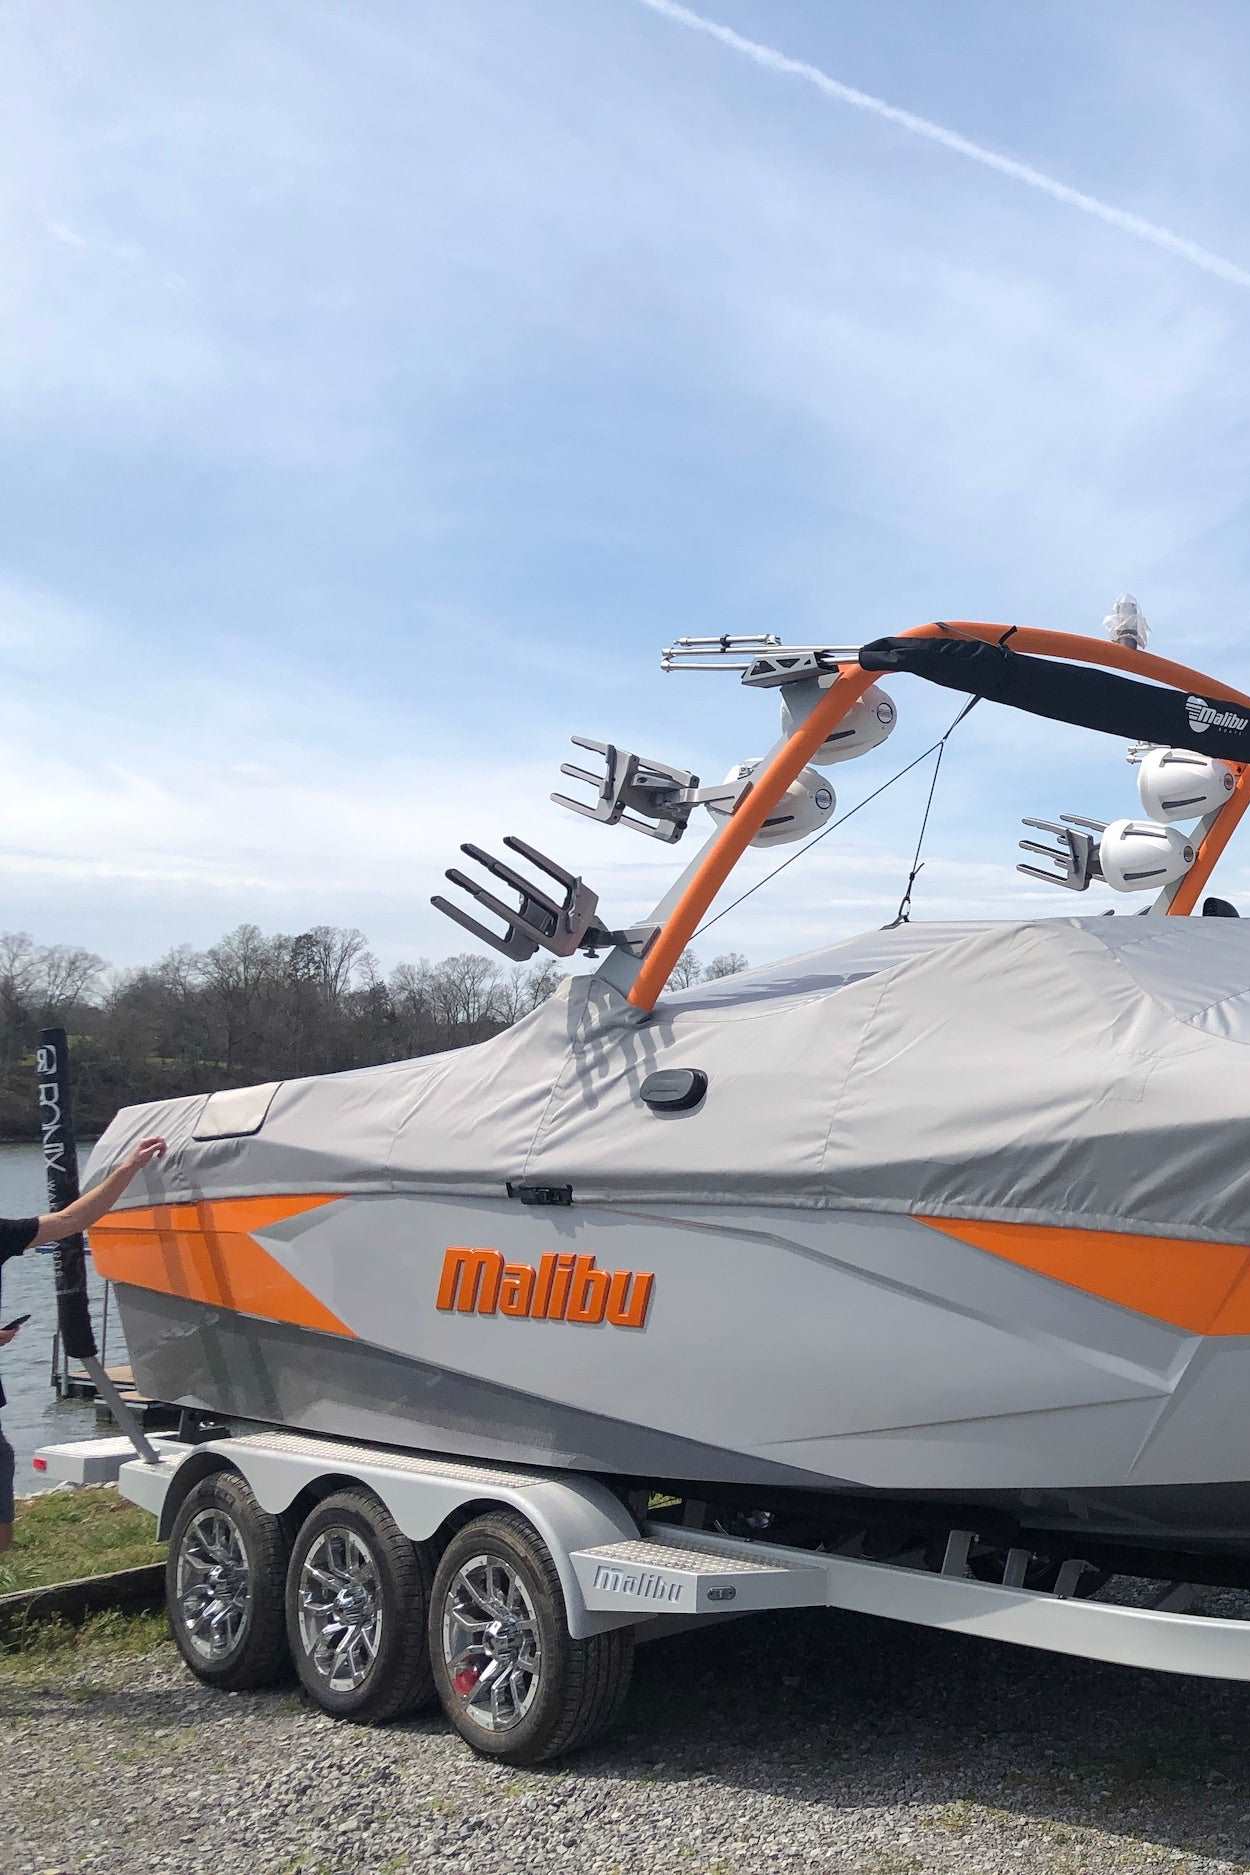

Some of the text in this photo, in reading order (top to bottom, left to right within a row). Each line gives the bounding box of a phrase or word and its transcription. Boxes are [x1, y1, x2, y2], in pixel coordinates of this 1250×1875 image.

[1199, 706, 1249, 730] Malibu
[436, 1246, 655, 1329] Malibu
[592, 1564, 684, 1603] Malibu
